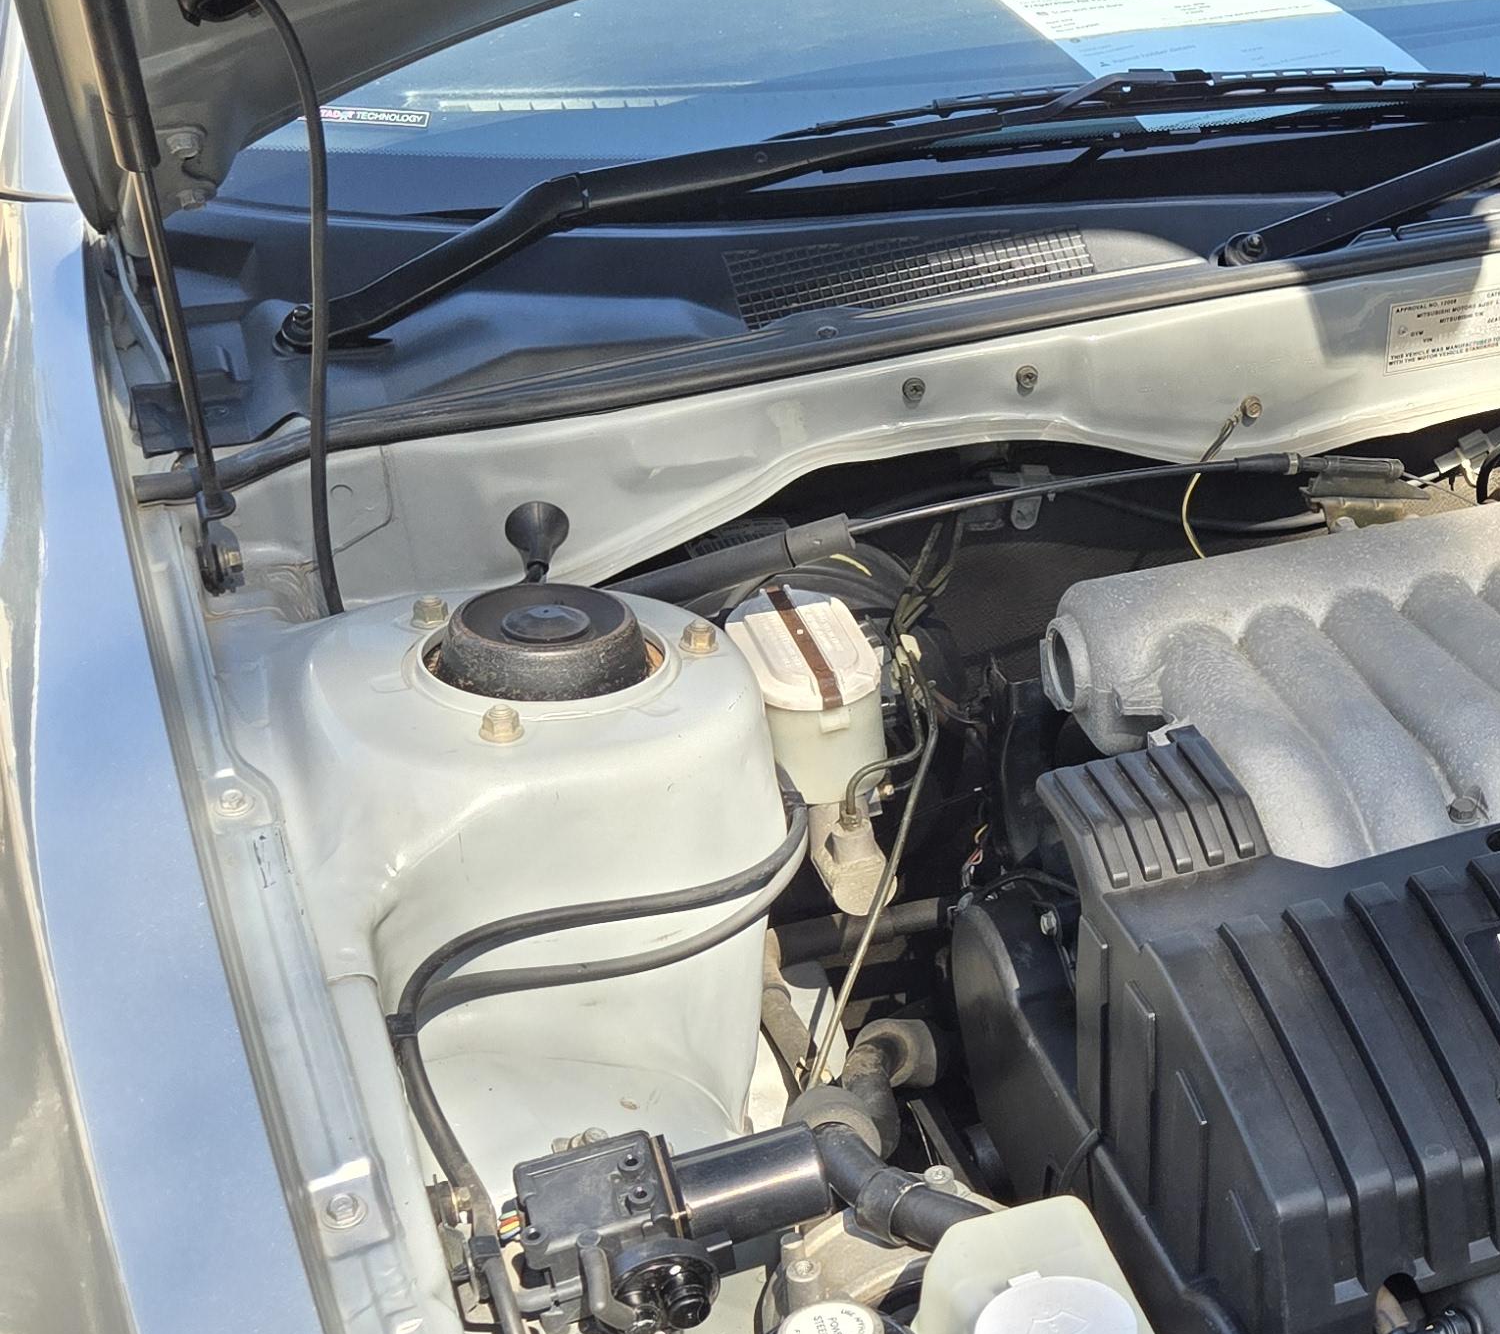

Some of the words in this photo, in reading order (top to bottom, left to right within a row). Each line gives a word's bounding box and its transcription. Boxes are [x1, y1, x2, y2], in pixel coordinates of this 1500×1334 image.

[356, 111, 424, 123] TECHNOLOGY
[1395, 303, 1427, 314] APPROVAL
[1417, 309, 1451, 318] MITSUBISHI
[1452, 304, 1477, 313] MOTORS
[1439, 313, 1473, 324] MITSUBISHI
[1405, 348, 1430, 357] VEHICLE
